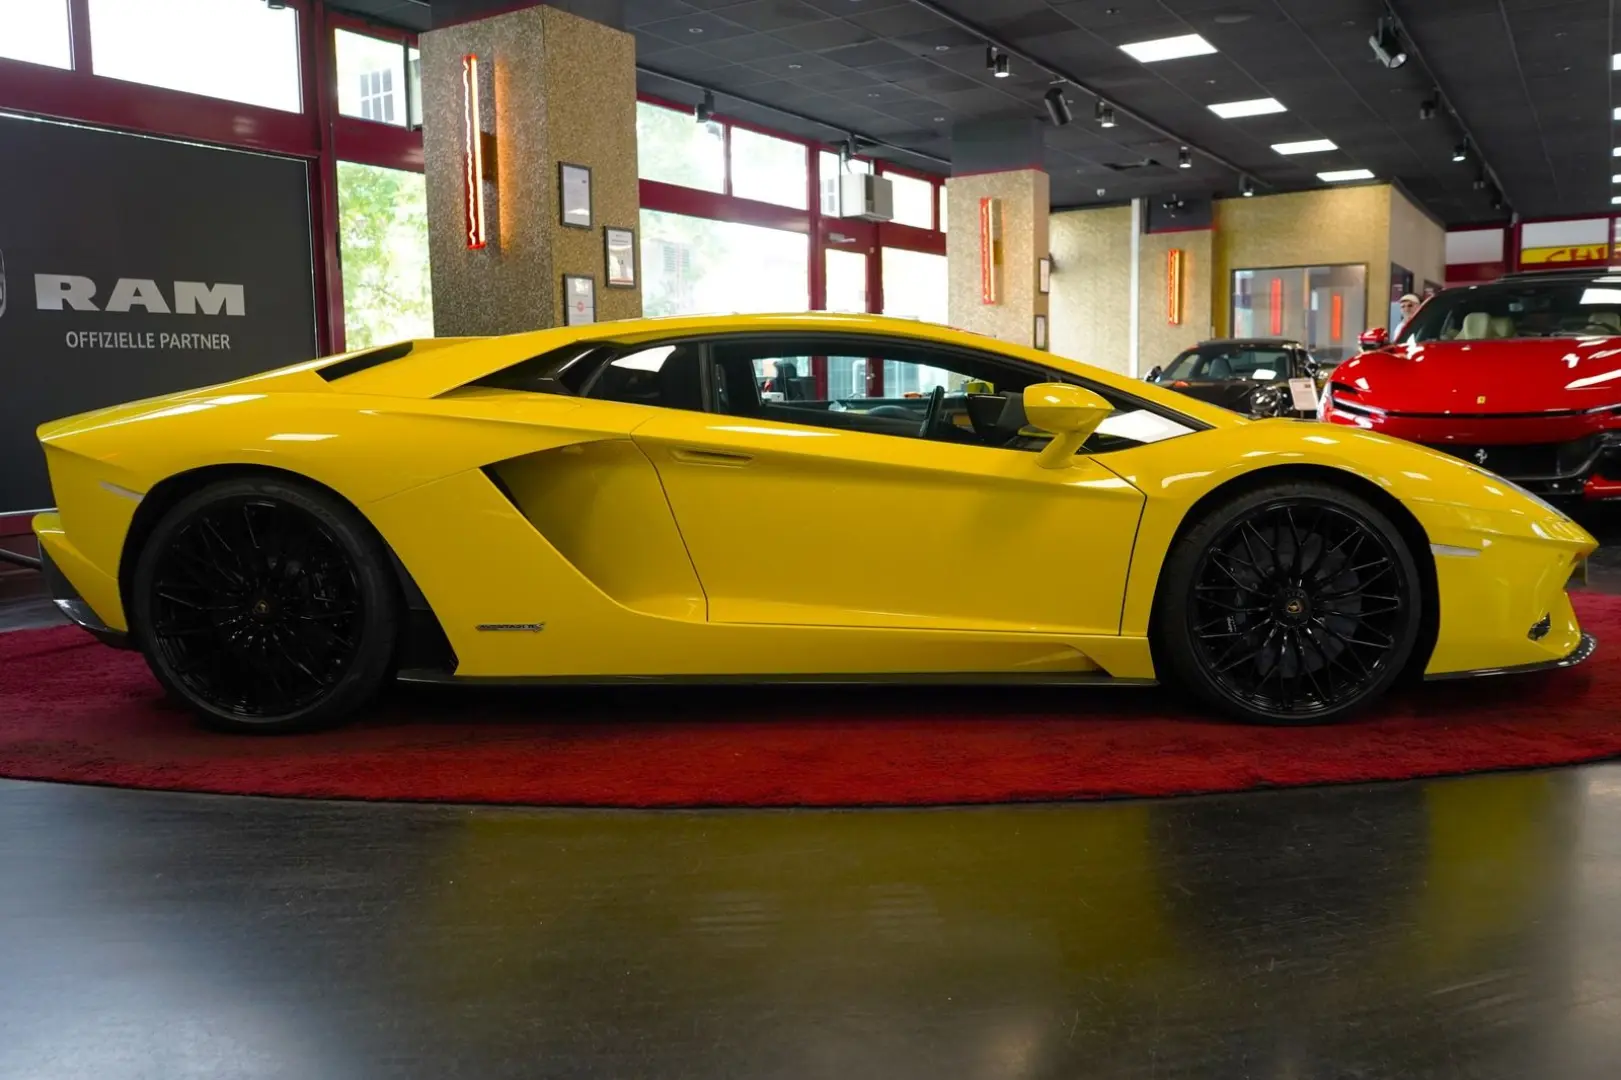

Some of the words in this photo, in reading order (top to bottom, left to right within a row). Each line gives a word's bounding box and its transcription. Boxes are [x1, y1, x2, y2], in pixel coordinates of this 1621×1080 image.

[34, 273, 245, 316] RAM
[65, 331, 155, 348] OFFIZIELLE
[160, 333, 230, 349] PARTNER
